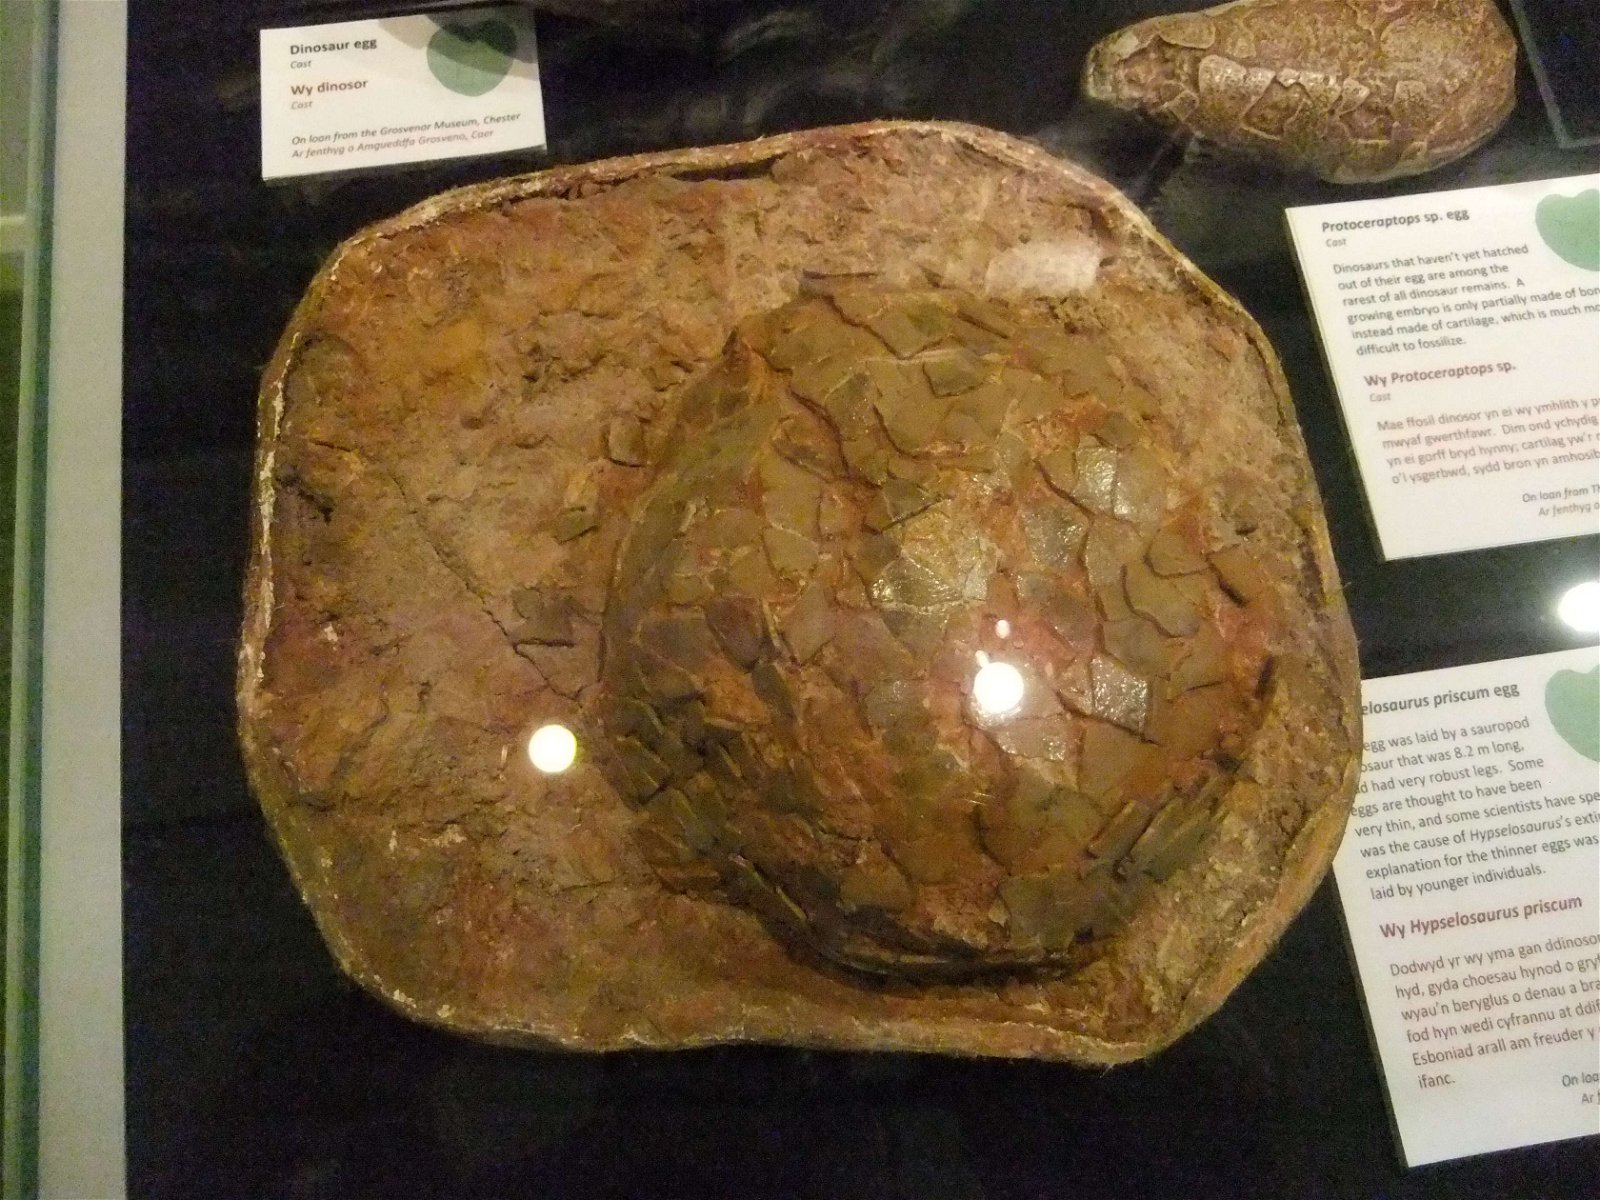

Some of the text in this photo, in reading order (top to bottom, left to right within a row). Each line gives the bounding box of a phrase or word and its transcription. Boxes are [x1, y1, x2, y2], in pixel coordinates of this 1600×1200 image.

[290, 39, 377, 54] Dinosaur egg
[290, 59, 311, 69] Cast
[291, 80, 368, 96] Wy dinosor
[291, 100, 312, 110] Cast
[292, 113, 520, 145] On loan from the Grosvenor Museum, Chester
[292, 149, 304, 158] Ar
[348, 144, 354, 152] o
[1322, 209, 1470, 232] Protoceraptops sp. egg
[1326, 238, 1346, 248] Cast
[1334, 244, 1528, 274] Dinosaurs that haven't yet hatched
[1338, 263, 1509, 290] out of their egg are among the
[1342, 278, 1524, 306] rarest of all dinosaur remains. A
[1347, 287, 1576, 326] growing embryo only partially made of
[1352, 304, 1581, 339] instead made of cartilage, which much
[1356, 336, 1466, 356] difficult to fossilize.
[1364, 360, 1516, 387] Wy Protoceraptops sp.
[1369, 392, 1391, 402] Cast
[1377, 412, 1481, 432] Mae ffosil dinosor
[1382, 436, 1421, 449] mwyaf
[1502, 424, 1526, 434] Dim
[1529, 419, 1551, 431] ond
[1449, 448, 1476, 460] bryd
[1474, 463, 1500, 475] sydd
[1503, 459, 1531, 471] bron
[1434, 689, 1489, 708] priscum
[1494, 683, 1520, 697] egg
[1364, 716, 1530, 753] egg was laid by a sauropod
[1397, 755, 1424, 767] that
[1427, 751, 1451, 763] was
[1454, 746, 1473, 758] 8.2
[1478, 746, 1490, 755] m
[1492, 738, 1524, 753] long,
[1371, 757, 1544, 791] had very robust legs. Some
[1351, 779, 1542, 818] eggs are thought to have been
[1355, 823, 1382, 838] very
[1386, 818, 1416, 832] thin,
[1418, 814, 1443, 826] and
[1446, 811, 1480, 823] some
[1484, 800, 1542, 818] scientists
[1545, 794, 1576, 808] have
[1360, 814, 1572, 858] was the cause of Hypselosaurus's
[1366, 835, 1599, 881] explanation for the thinner eggs was
[1370, 862, 1546, 900] laid by younger individuals.
[1379, 896, 1583, 939] Wy Hypselosaurus priscum
[1390, 956, 1444, 977] Dodwyd
[1448, 956, 1460, 969] yr
[1464, 953, 1483, 965] wy
[1487, 947, 1515, 963] yma
[1519, 943, 1542, 959] gan
[1395, 960, 1574, 1000] hyd, gyda choesau hynod o
[1401, 984, 1577, 1022] wyau'n beryglus o denau a
[1407, 1005, 1572, 1043] fod hyn wedi cyfrannu at
[1412, 1042, 1474, 1066] Esboniad
[1478, 1038, 1506, 1056] arall
[1510, 1037, 1531, 1050] am
[1533, 1027, 1583, 1047] freuder
[1587, 1027, 1595, 1040] y
[1418, 1073, 1455, 1089] ifanc.
[1562, 1074, 1578, 1087] On
